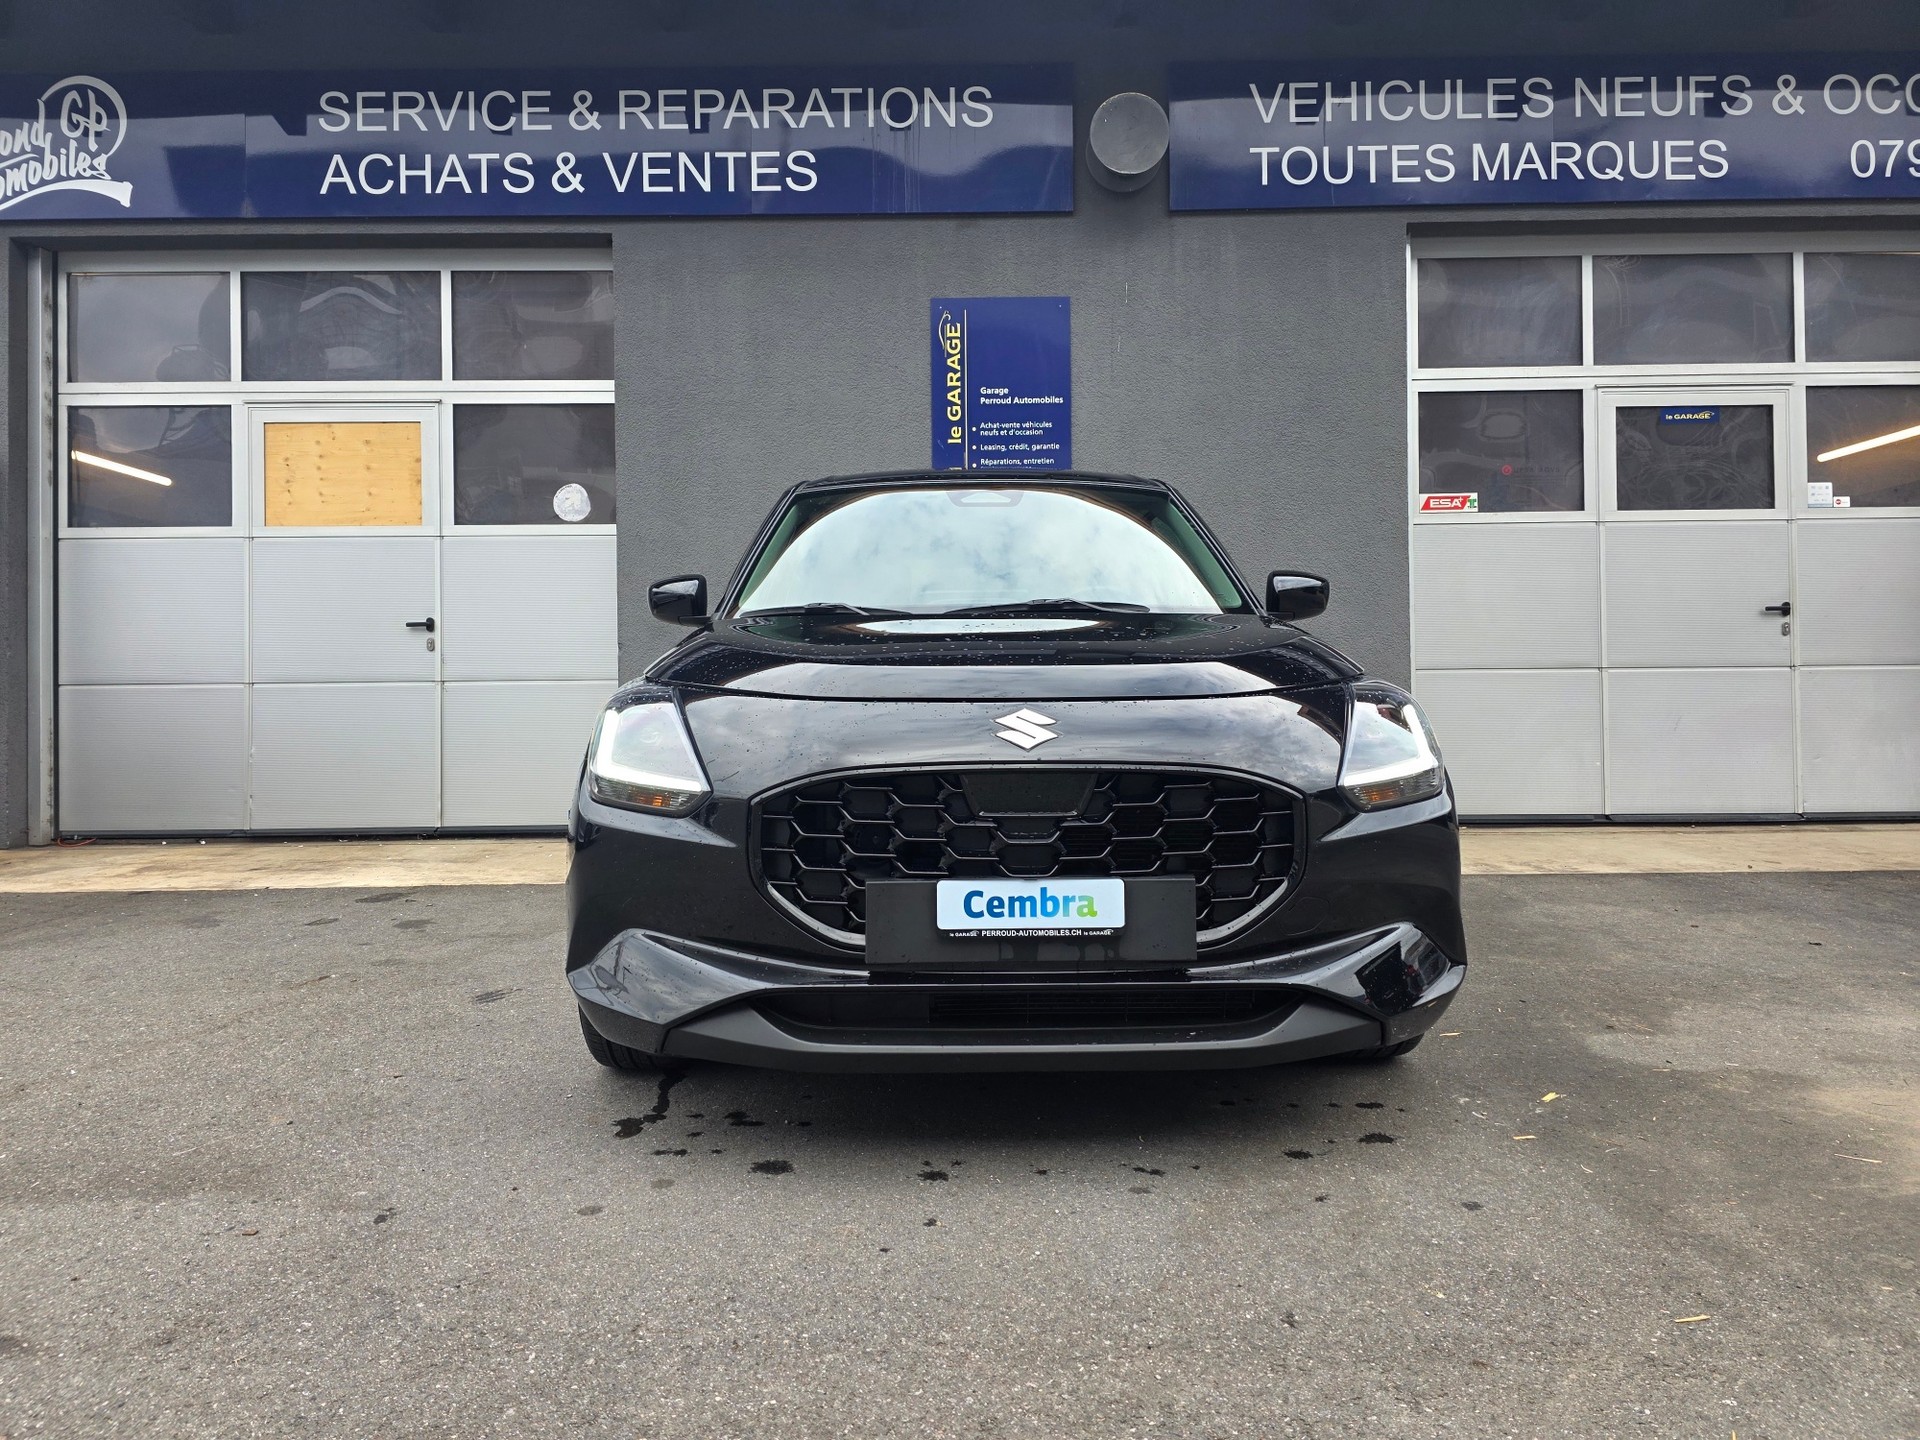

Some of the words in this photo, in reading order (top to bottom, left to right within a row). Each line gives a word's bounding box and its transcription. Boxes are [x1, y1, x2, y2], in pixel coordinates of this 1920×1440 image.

[1249, 77, 1555, 123] VEHICULES
[1574, 74, 1753, 118] NEUFS
[1771, 74, 1806, 116] &
[318, 90, 552, 132] SERVICE
[568, 89, 602, 131] &
[618, 85, 994, 131] REPARATIONS
[1249, 143, 1456, 186] TOUTES
[1472, 139, 1729, 182] MARQUES
[319, 153, 536, 195] ACHATS
[551, 151, 586, 194] &
[602, 149, 818, 193] VENTES
[946, 322, 962, 421] GARAGE
[980, 387, 1009, 396] Garage
[980, 396, 1012, 405] Perroud
[1013, 396, 1064, 404] Automobiles
[1673, 412, 1711, 420] GARAGE
[980, 421, 1021, 429] Achat-vente
[947, 426, 962, 444] le
[1008, 428, 1044, 436] d'occasion
[980, 444, 1007, 452] Leasing,
[1008, 443, 1030, 451] crédit,
[1031, 443, 1060, 451] garantie
[980, 458, 1022, 466] Réparations,
[1023, 457, 1055, 465] entretien
[1429, 498, 1463, 509] ESA
[963, 886, 1098, 919] Cembra
[981, 929, 1082, 937] PERROUD-AUTOMOBILES.CH
